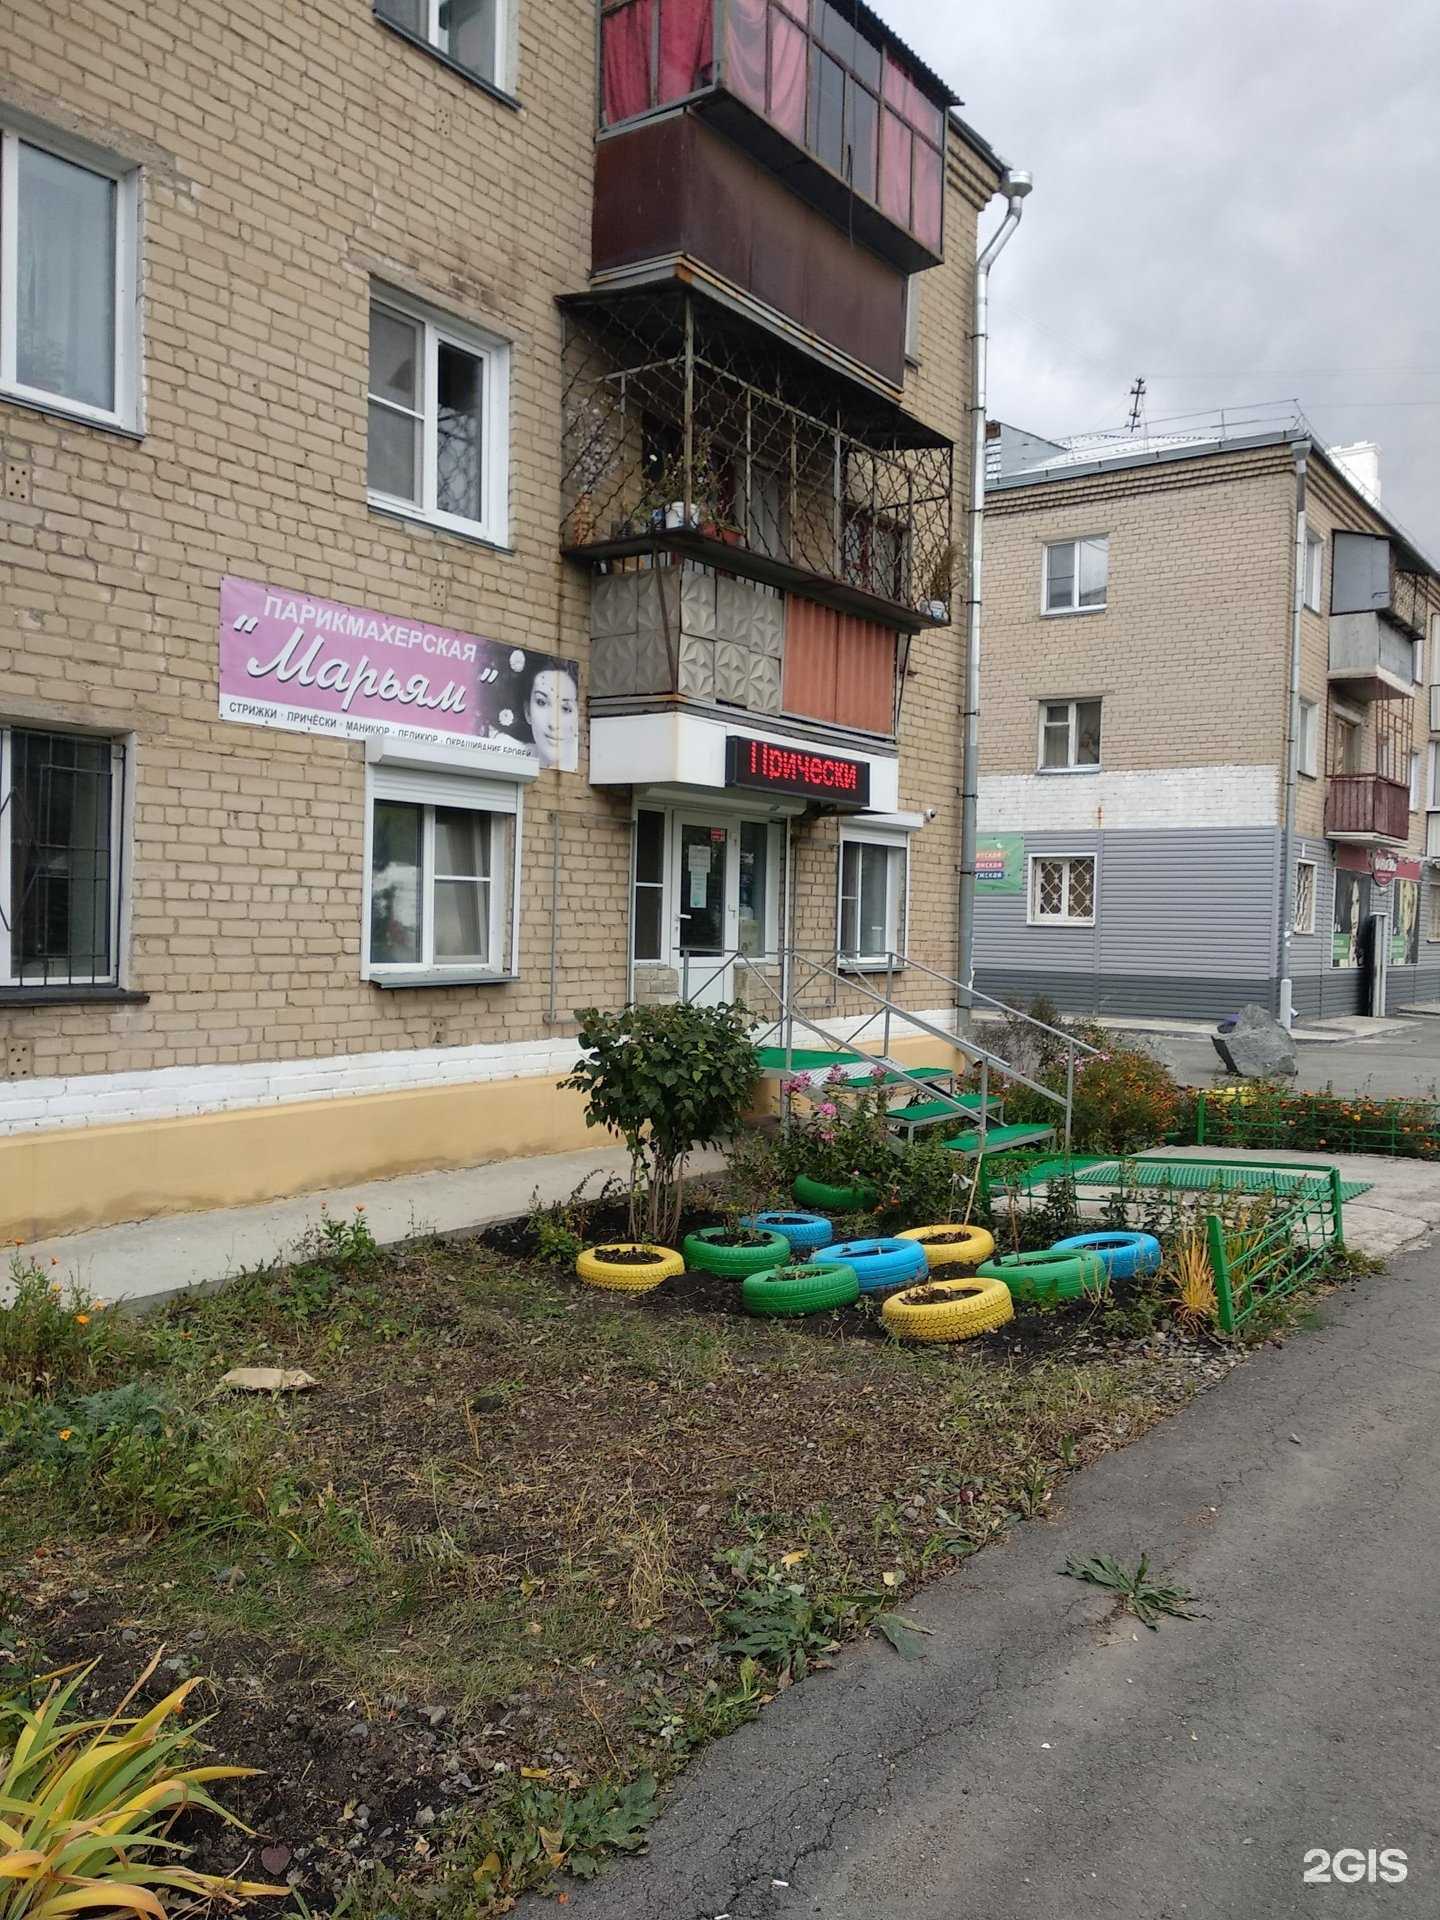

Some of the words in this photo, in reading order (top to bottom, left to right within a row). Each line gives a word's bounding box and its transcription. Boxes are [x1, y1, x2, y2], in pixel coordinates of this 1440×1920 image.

[263, 595, 477, 663] ПАРИКМАХЕРСКАЯ
[229, 702, 277, 719] СТРИЖКИ
[345, 721, 390, 735] МАНИКЮР
